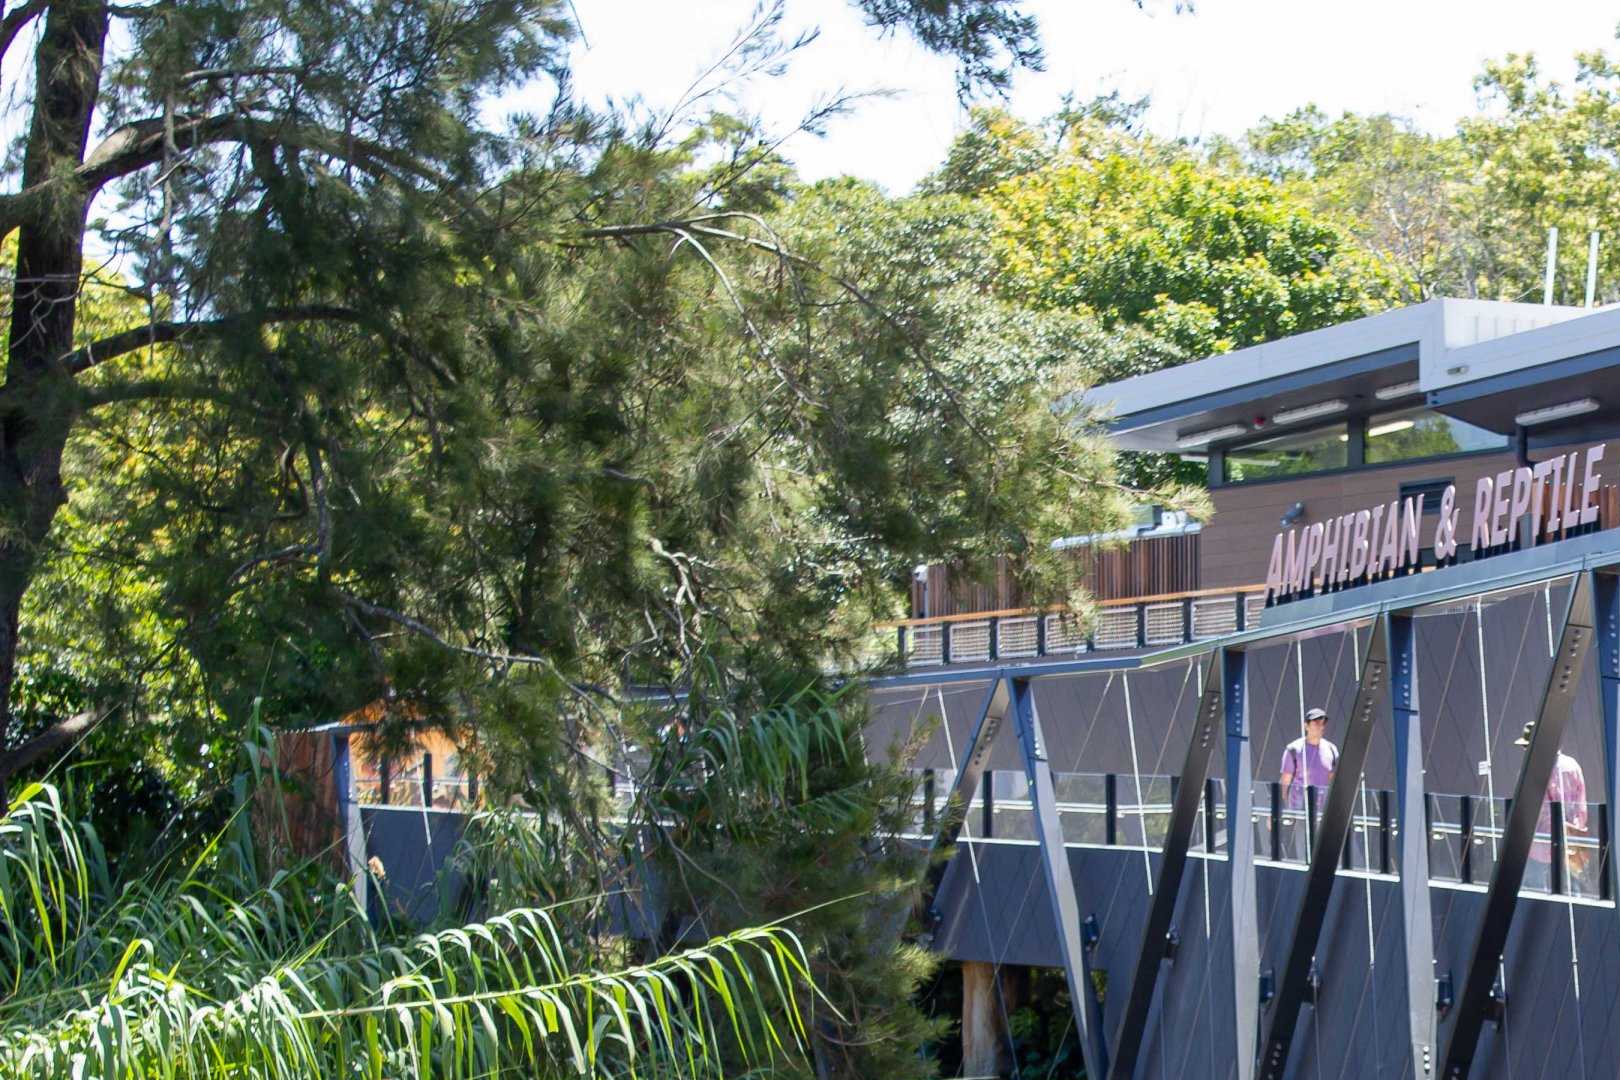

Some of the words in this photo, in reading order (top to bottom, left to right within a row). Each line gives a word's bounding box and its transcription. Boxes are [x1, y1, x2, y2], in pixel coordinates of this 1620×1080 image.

[1265, 493, 1425, 600] AMPHIBIAN
[1434, 485, 1461, 560] &
[1471, 443, 1606, 552] REPTILE
